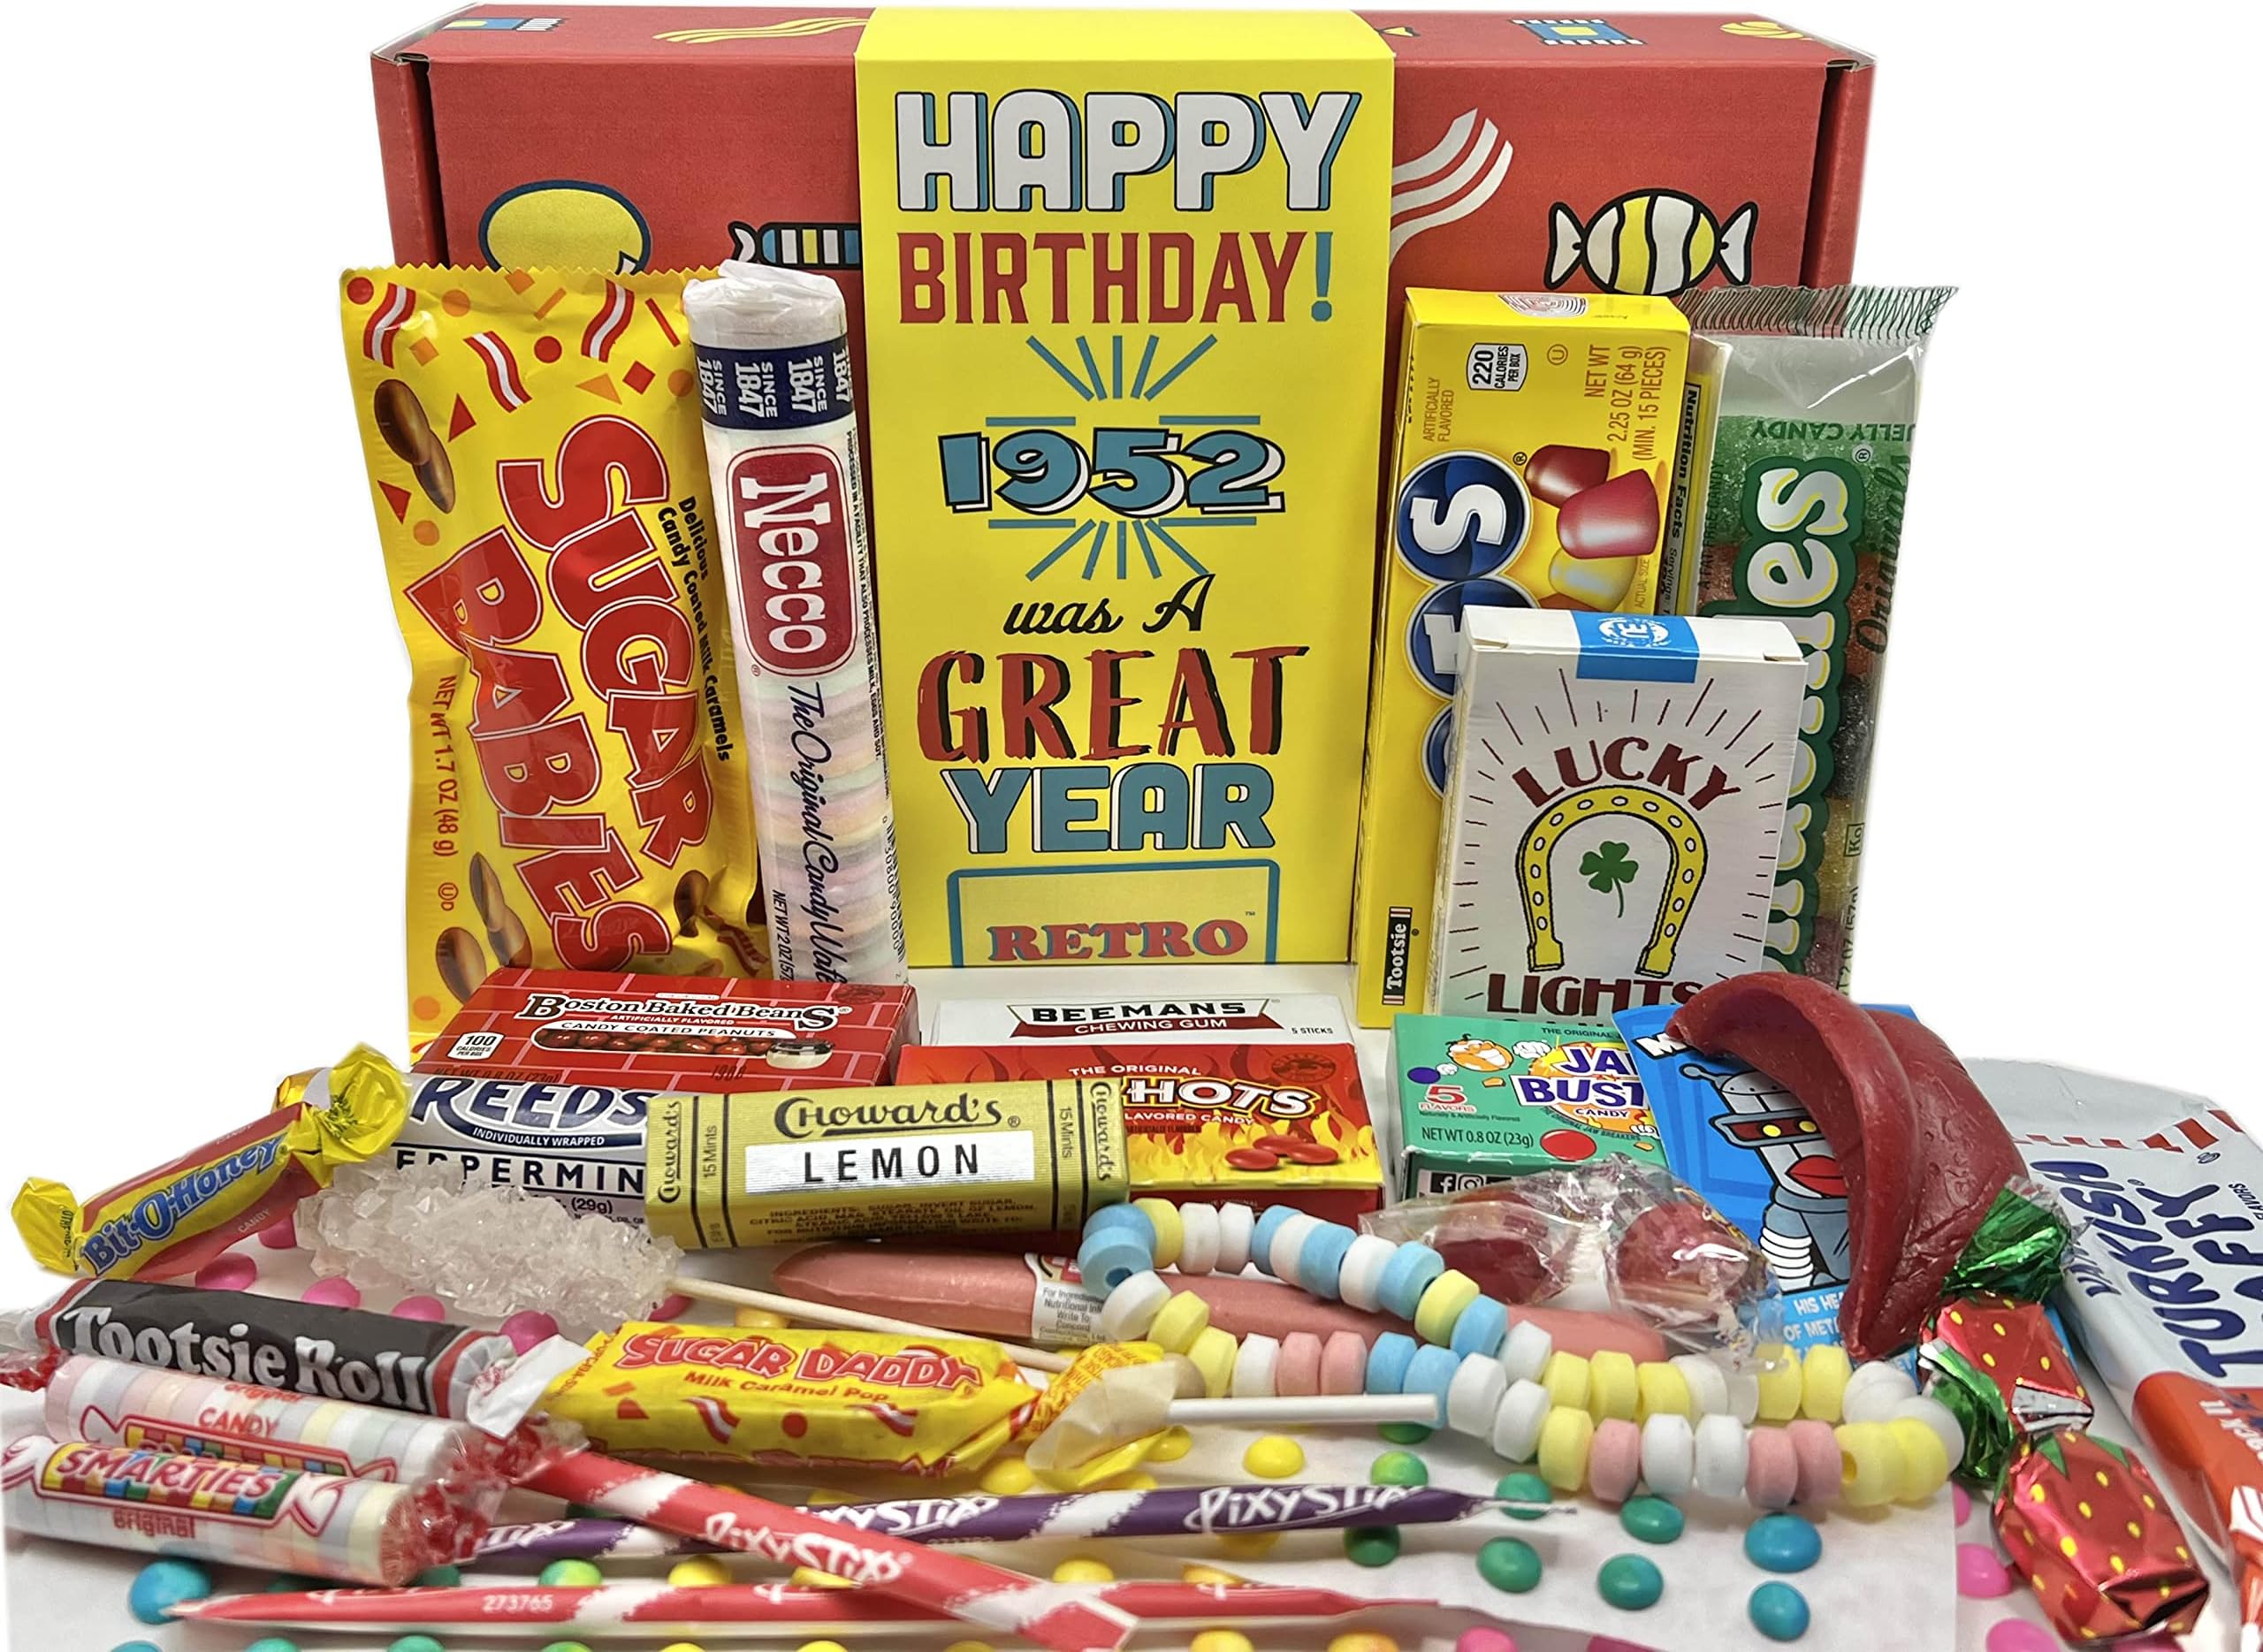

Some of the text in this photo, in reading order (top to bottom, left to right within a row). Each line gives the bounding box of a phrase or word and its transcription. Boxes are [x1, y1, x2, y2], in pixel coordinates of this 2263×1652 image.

[895, 89, 1361, 211] HAPPY
[896, 232, 1333, 324] BIRTHDAY!
[697, 356, 718, 415] 1847
[788, 358, 818, 414] 1847
[813, 355, 828, 412] SINCE
[1472, 350, 1494, 384] 220
[1494, 346, 1509, 389] CALORIES
[1507, 353, 1521, 382] PER BOX
[1584, 345, 1611, 398] NET WT
[712, 360, 728, 415] SINCE
[735, 362, 766, 418] 1847
[761, 362, 778, 418] SINCE
[1612, 388, 1634, 407] OZ
[1632, 346, 1672, 461] (MIN. 15 PIECES)
[1423, 377, 1441, 442] ARTIFICIALLY
[1438, 389, 1455, 442] FLAVORED
[1607, 407, 1630, 442] 2.25
[1750, 420, 1844, 441] CANDY
[939, 428, 1285, 518] 1952
[1672, 390, 1697, 538] Nutrition Facts
[739, 472, 829, 654] Necco
[1002, 574, 1215, 635] was A
[496, 415, 714, 867] SUGAR
[658, 506, 691, 567] Candy
[683, 570, 707, 634] Coated
[705, 674, 734, 762] Caramels
[433, 675, 457, 710] NET
[787, 681, 825, 731] The
[917, 647, 1310, 763] GREAT
[431, 713, 452, 740] WT
[404, 527, 673, 972] BABIES
[434, 745, 455, 773] 1.7
[438, 779, 459, 804] OZ
[790, 730, 834, 841] Original
[1512, 736, 1741, 811] LUCKY
[433, 809, 459, 834] (48
[941, 764, 1276, 854] YEAR
[800, 839, 841, 922] Candy
[772, 889, 788, 915] NET
[774, 916, 790, 935] WT
[987, 920, 1248, 961] RETRO
[778, 944, 793, 961] OZ
[1386, 923, 1407, 990] Tootsie
[517, 994, 640, 1019] Boston
[645, 1001, 735, 1018] Baked
[1032, 1002, 1246, 1022] BEEMANS
[1074, 1017, 1228, 1034] CHEWING GUM
[463, 1034, 495, 1047] 100
[560, 1022, 776, 1038] CANDY COATED PEANUTS
[1564, 1029, 1614, 1039] ORIGINAL
[1069, 1064, 1201, 1076] THE ORIGINAL
[1563, 1046, 1634, 1075] JA
[410, 1077, 656, 1128] REEDS
[1129, 1079, 1313, 1116] HOTS
[1428, 1086, 1465, 1104] 5
[1575, 1108, 1628, 1118] CANDY
[472, 1127, 606, 1146] INDIVIDUALLY WRAPPED
[1200, 1114, 1254, 1125] CANDY
[1421, 1126, 1535, 1149] NET WT 0.8 OZ (23g)
[703, 1123, 718, 1161] Mints
[1061, 1122, 1074, 1160] Mints
[804, 1143, 979, 1184] LEMON
[571, 1197, 613, 1214] (29g)
[2030, 1161, 2263, 1377] TURKISH
[1794, 1296, 1819, 1315] HIS
[1783, 1323, 1802, 1342] OF
[64, 1306, 426, 1412] Tootsie Roll
[613, 1332, 797, 1378] SUGAR
[796, 1346, 983, 1389] DADDY
[682, 1370, 889, 1404] Milk Caramel Pop
[198, 1406, 281, 1437] CANDY
[57, 1450, 284, 1498] SMARTIES
[113, 1508, 195, 1539] original
[482, 1594, 553, 1613] 273765
